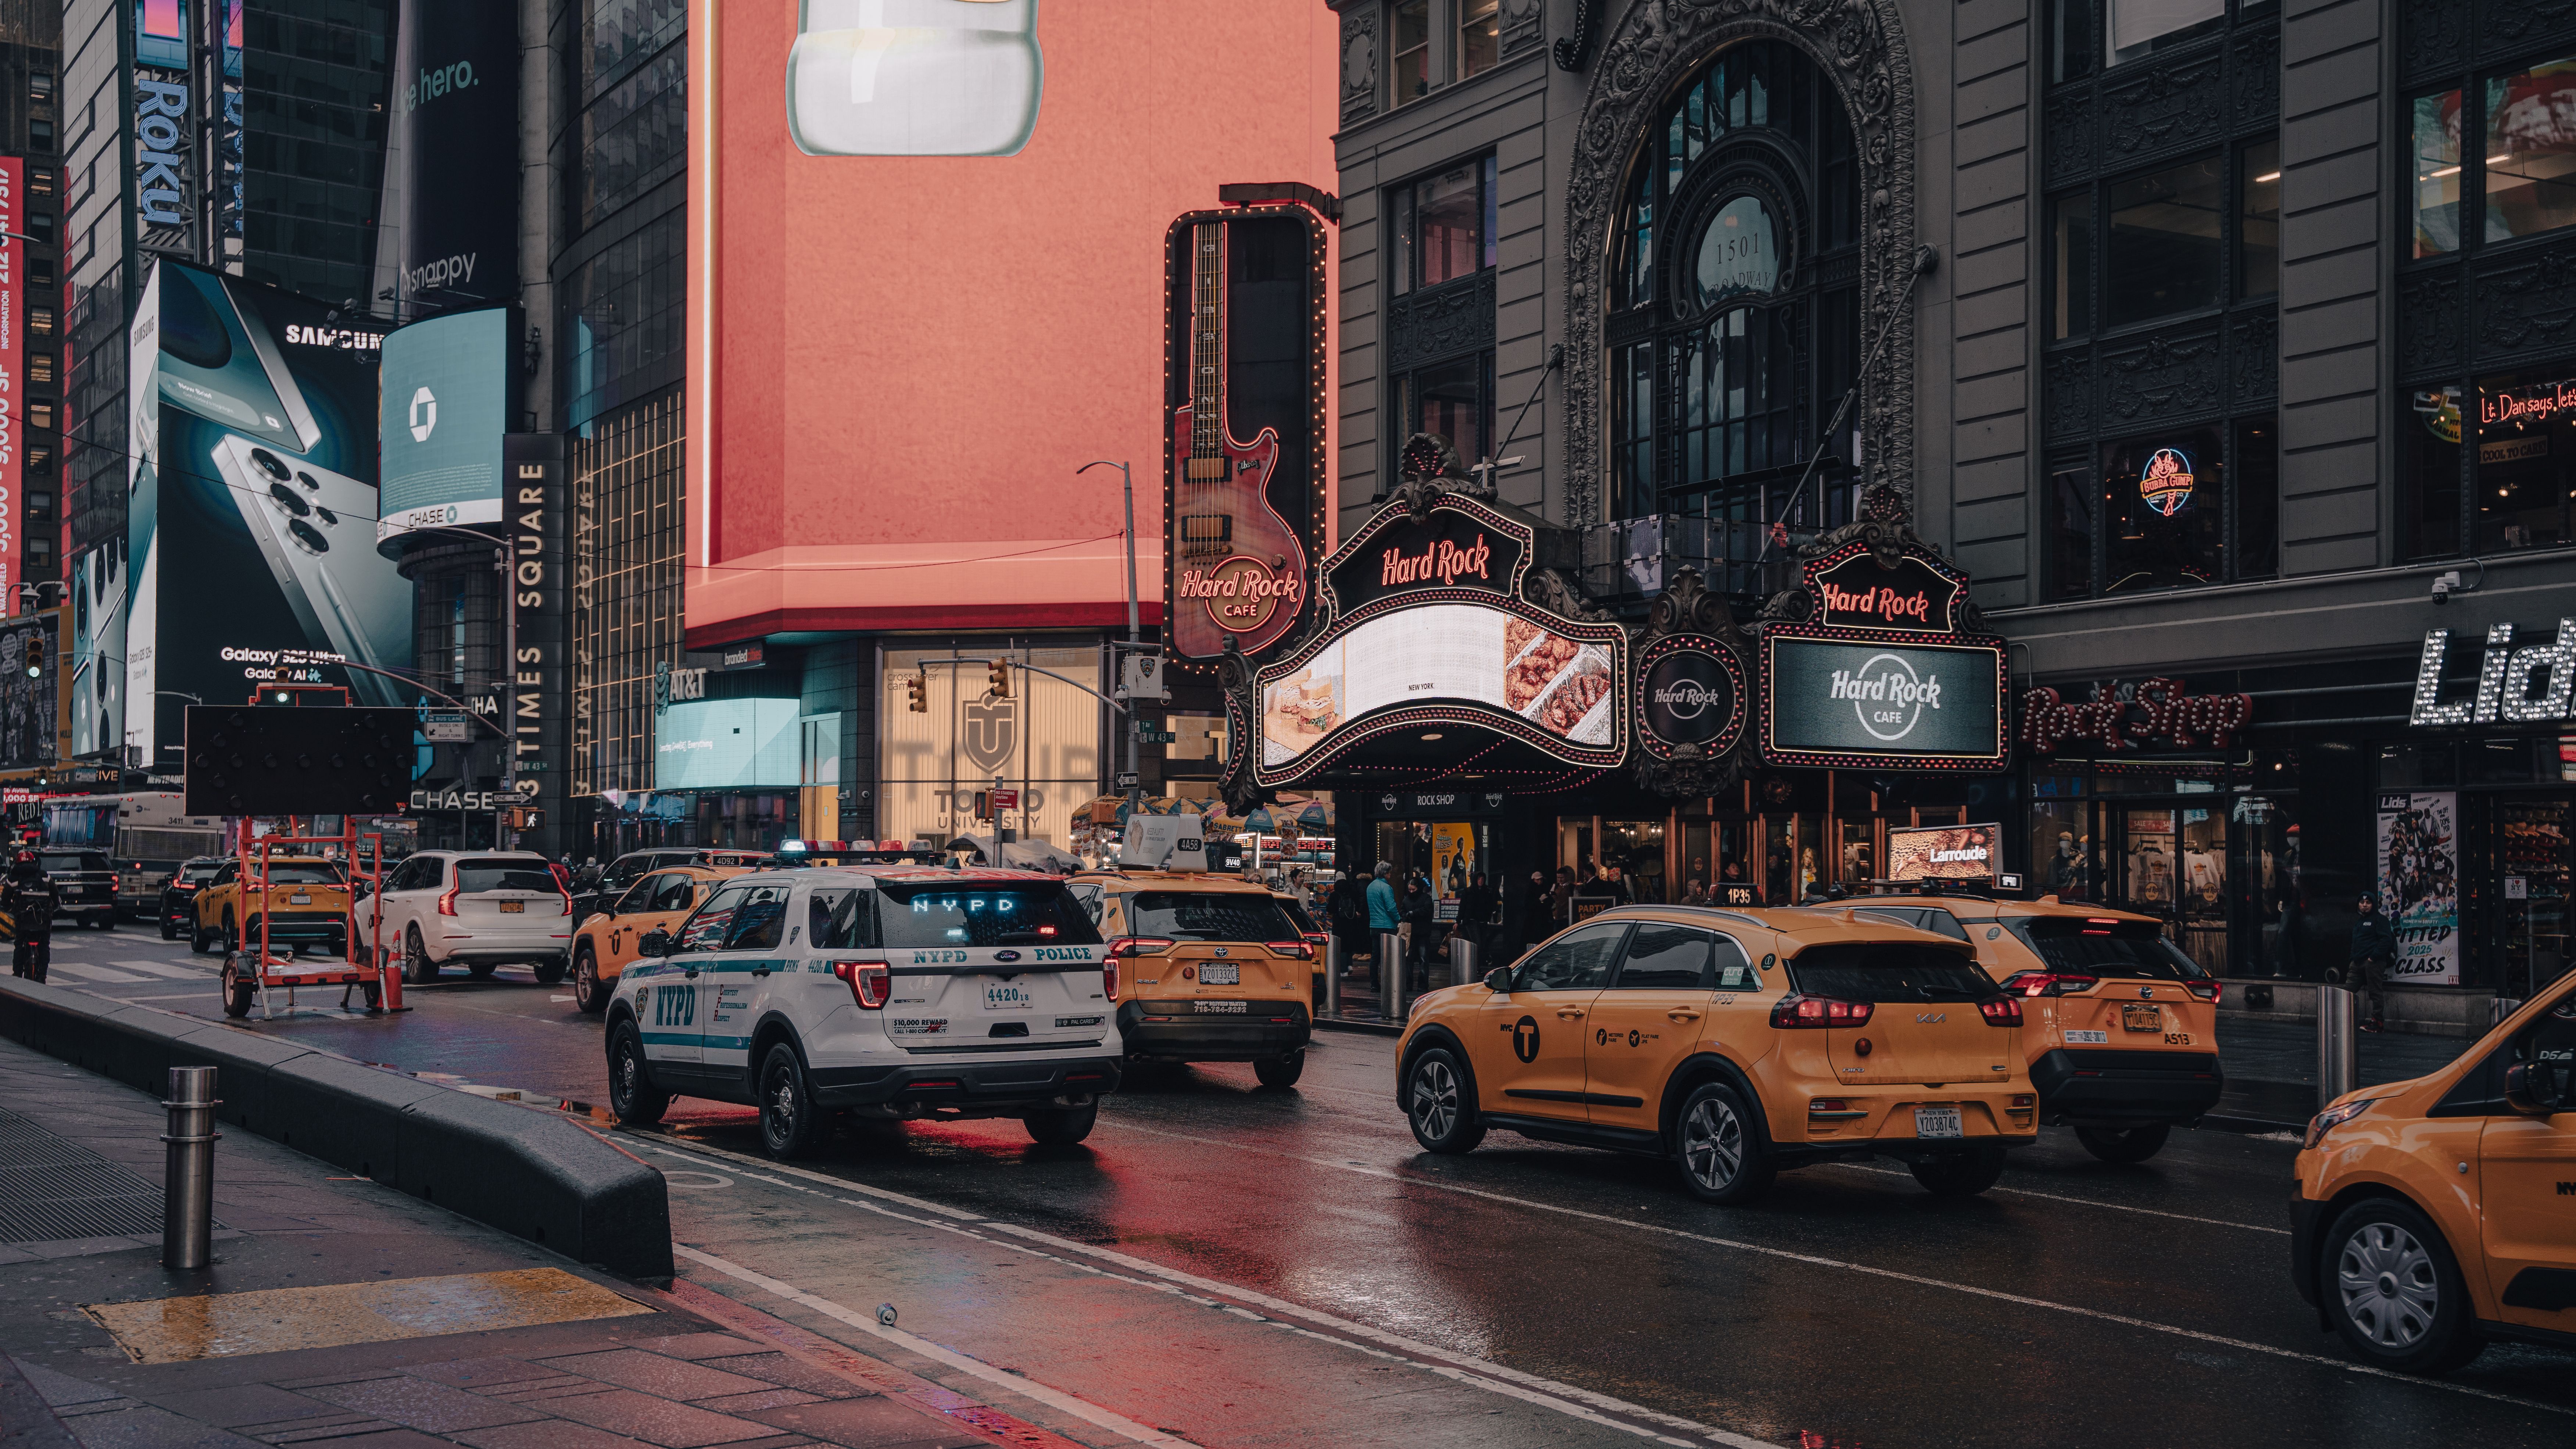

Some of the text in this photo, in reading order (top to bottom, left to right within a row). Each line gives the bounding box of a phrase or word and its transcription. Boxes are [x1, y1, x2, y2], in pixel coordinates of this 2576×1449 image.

[420, 61, 479, 104] hero.
[1717, 232, 1759, 265] 1501
[411, 253, 476, 291] snappy
[134, 315, 154, 347] SAMSUNG
[2499, 394, 2526, 421] Dan
[2483, 449, 2505, 461] COOL
[2507, 446, 2519, 457] TO
[2144, 476, 2191, 493] BUBBA GUMP
[409, 509, 444, 527] CHASE
[518, 464, 544, 608] SQUARE
[1382, 534, 1489, 586] Hard Rock
[1181, 570, 1299, 602] Hard Rock
[1823, 583, 1928, 622] Hard Rock
[1224, 605, 1257, 617] CAFE
[221, 647, 278, 666] Galaxy
[244, 668, 306, 680] Galay AI
[2409, 617, 2576, 726] Lid
[670, 668, 707, 701] AT&T
[1831, 670, 1941, 709] Hard Rock
[517, 647, 542, 755] TIMES
[1654, 688, 1718, 706] Hard Rock
[1874, 711, 1902, 723] CAFE
[2021, 677, 2253, 754] Rock Shop
[1142, 722, 1144, 731] 7
[1148, 733, 1155, 741] W
[1158, 733, 1166, 742] 43
[523, 762, 540, 770] W 43
[411, 791, 496, 810] CHASE
[1417, 794, 1455, 806] ROCK SHOP
[2381, 797, 2406, 808] Lids
[18, 803, 36, 823] RED
[938, 816, 1040, 829] UNIVESITY
[1214, 823, 1242, 833] SABRETT
[1181, 840, 1198, 850] 4A58
[717, 856, 735, 866] 4D92
[1226, 858, 1241, 867] 9V40
[1728, 888, 1750, 904] 1P35
[914, 900, 1012, 911] NYPD
[1578, 904, 1606, 913] PARTY
[2393, 925, 2451, 943] FITTED
[913, 951, 967, 963] NYPD
[1034, 948, 1092, 960] POLICE
[2407, 945, 2432, 956] 2025
[784, 960, 822, 973] PBMS 4420
[1724, 967, 1743, 976] curb
[2395, 956, 2446, 974] CLASS
[1203, 969, 1235, 979] Y201332C
[2448, 976, 2459, 984] XXL
[720, 984, 739, 996] COURTESY
[988, 988, 1018, 1001] 4420
[656, 985, 696, 1026] NYPD
[716, 997, 748, 1009] PROFESSIONALISM
[1712, 993, 1738, 1005] 1P35
[713, 1010, 730, 1022] RESPECT
[1917, 1013, 1946, 1023] KIA
[1500, 1024, 1534, 1056] NYC T
[2164, 1033, 2190, 1045] A513
[1920, 1116, 1958, 1131] Y203874C
